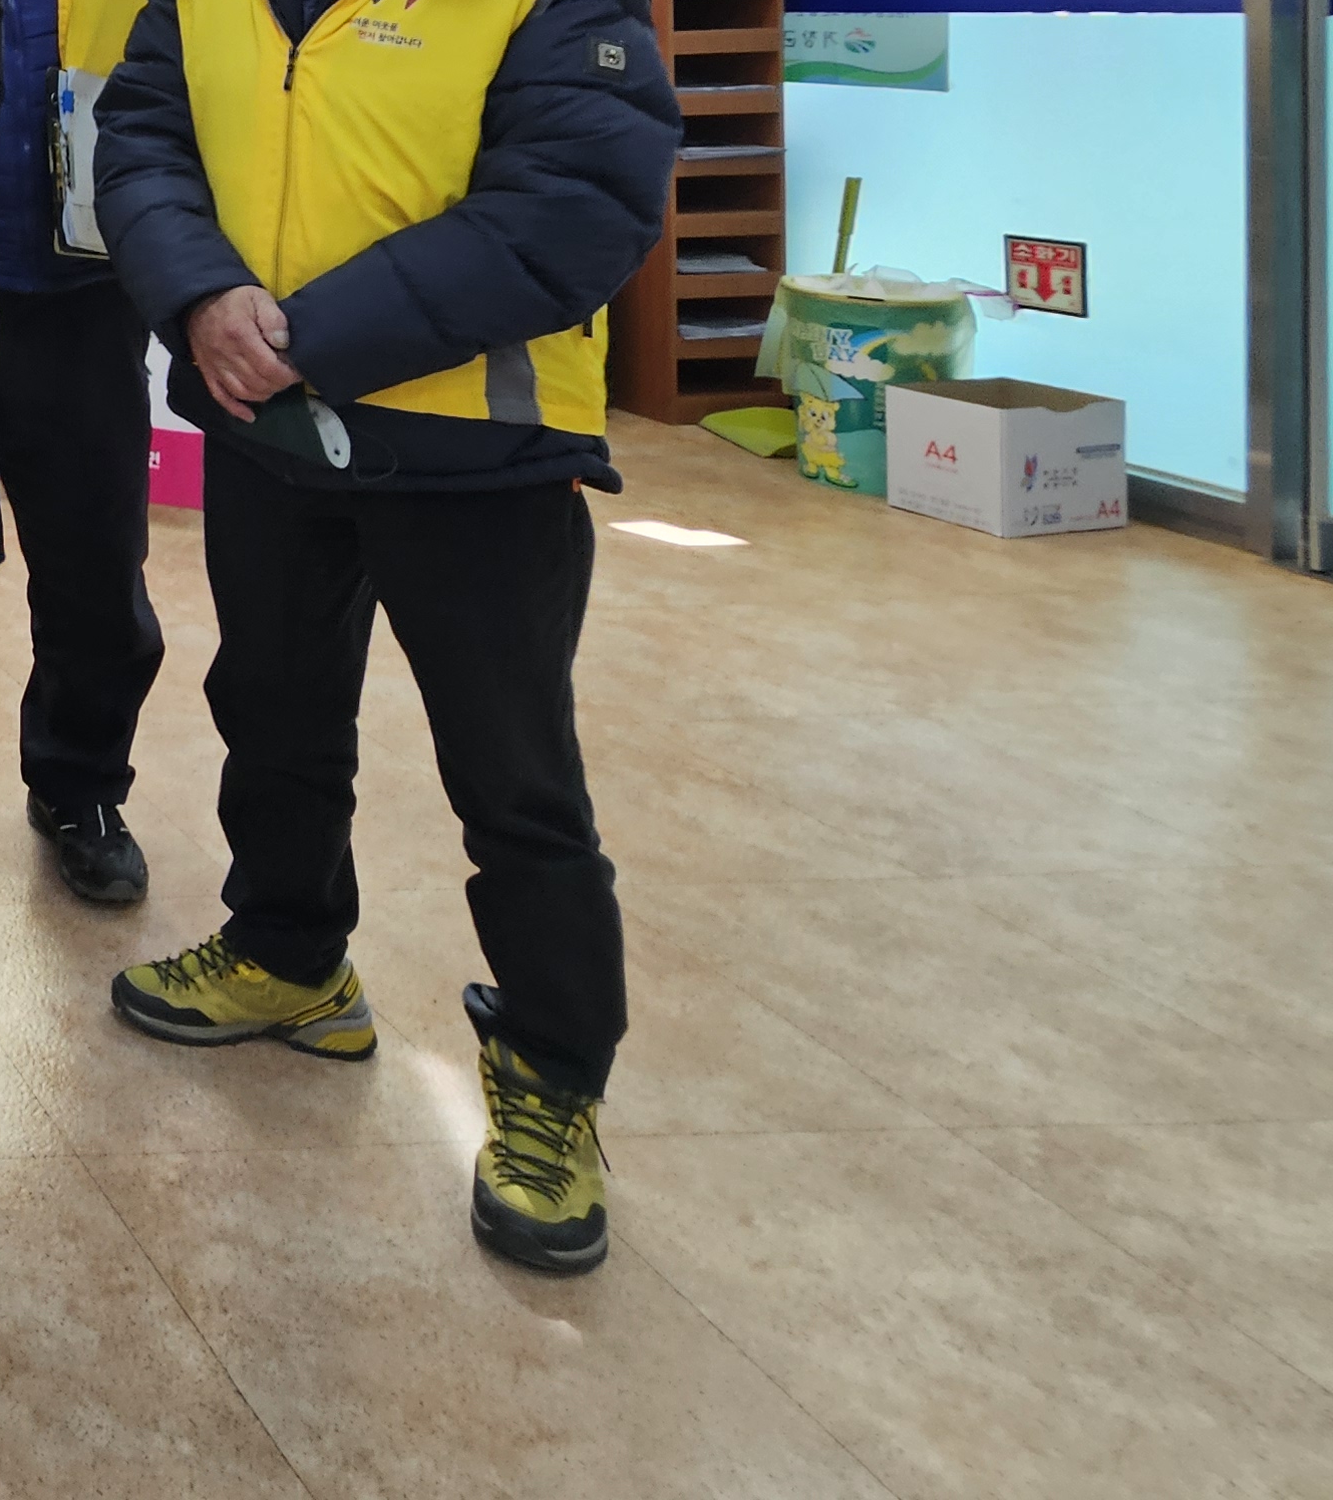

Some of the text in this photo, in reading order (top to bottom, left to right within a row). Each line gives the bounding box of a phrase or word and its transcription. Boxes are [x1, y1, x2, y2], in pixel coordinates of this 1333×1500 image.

[1012, 243, 1076, 263] 소화기
[925, 440, 958, 465] A4
[1097, 500, 1122, 519] A4
